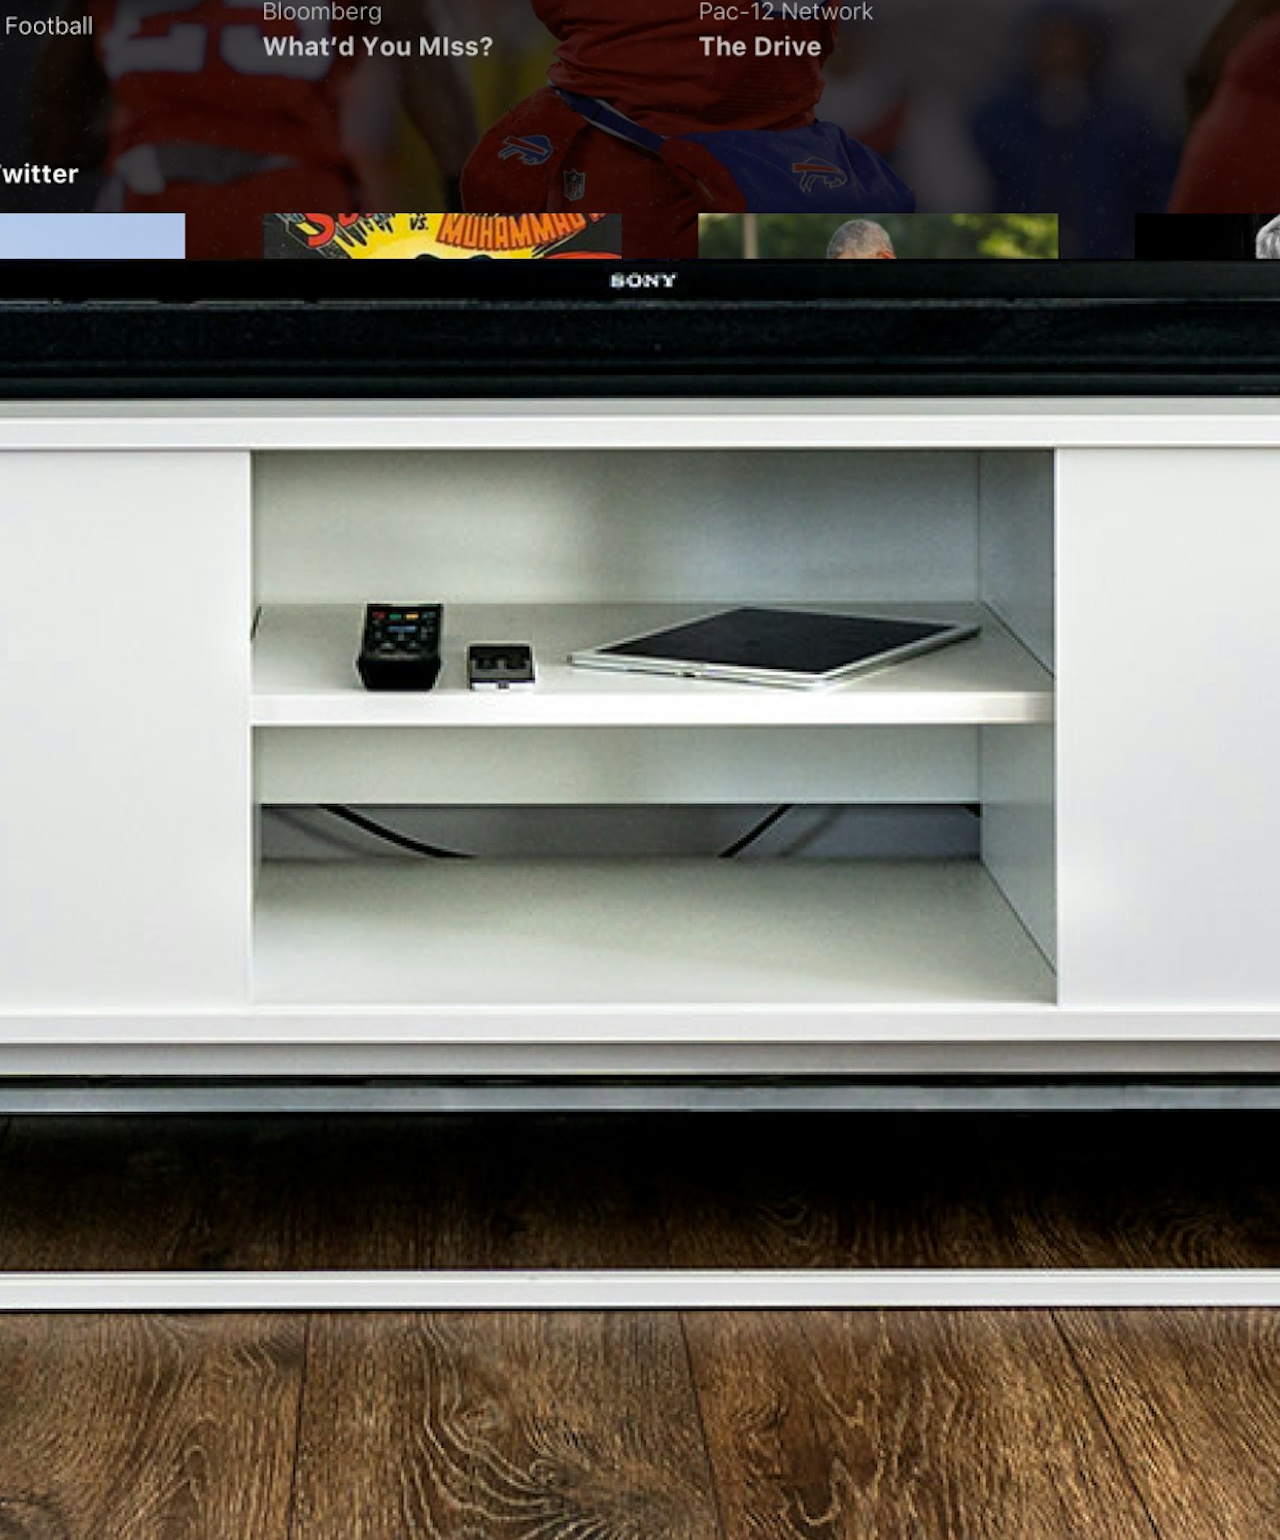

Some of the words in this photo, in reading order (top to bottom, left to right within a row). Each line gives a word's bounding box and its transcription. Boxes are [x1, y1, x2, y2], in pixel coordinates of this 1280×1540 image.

[264, 2, 381, 24] Bloomberg
[701, 2, 773, 19] Pac-12
[783, 2, 872, 19] Network
[6, 16, 92, 35] Football
[363, 37, 413, 56] You
[699, 36, 746, 56] The
[755, 36, 821, 56] Drive
[610, 273, 677, 288] SONY
